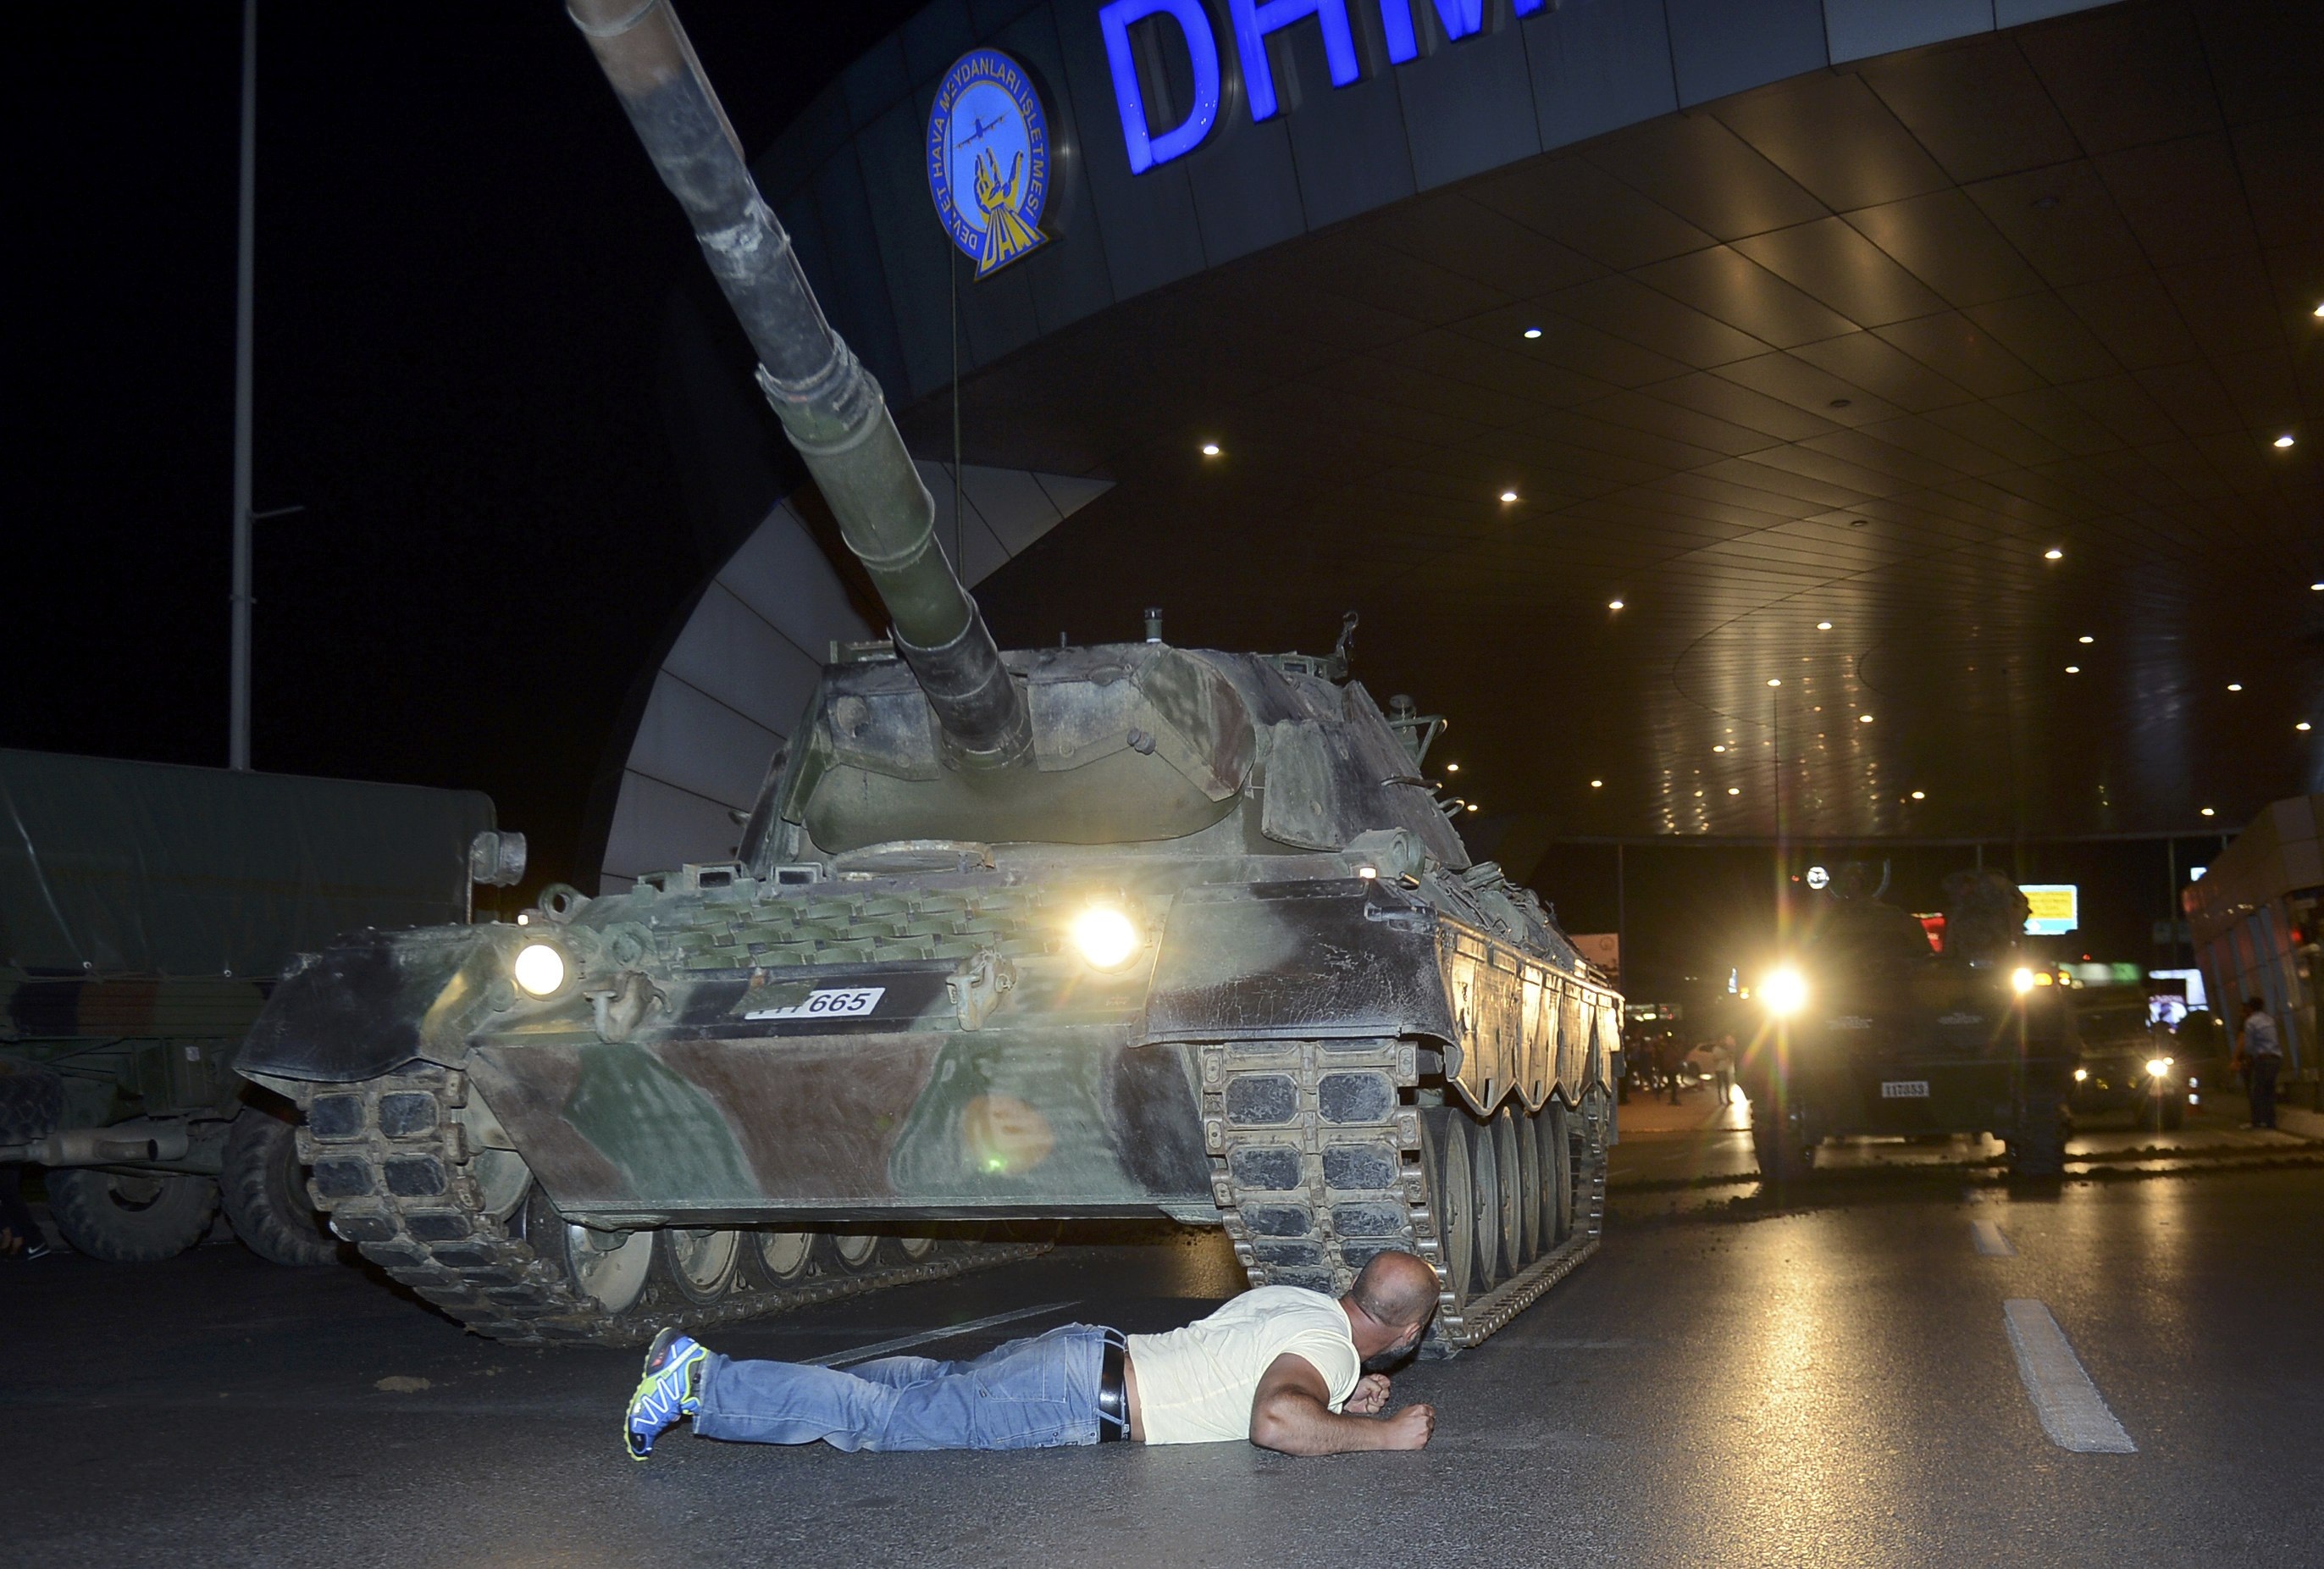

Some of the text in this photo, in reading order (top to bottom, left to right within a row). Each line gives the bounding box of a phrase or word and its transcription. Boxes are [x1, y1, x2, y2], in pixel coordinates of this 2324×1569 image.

[932, 118, 944, 178] HAVA
[939, 58, 1021, 113] MEYDANLARI
[758, 992, 872, 1014] 665
